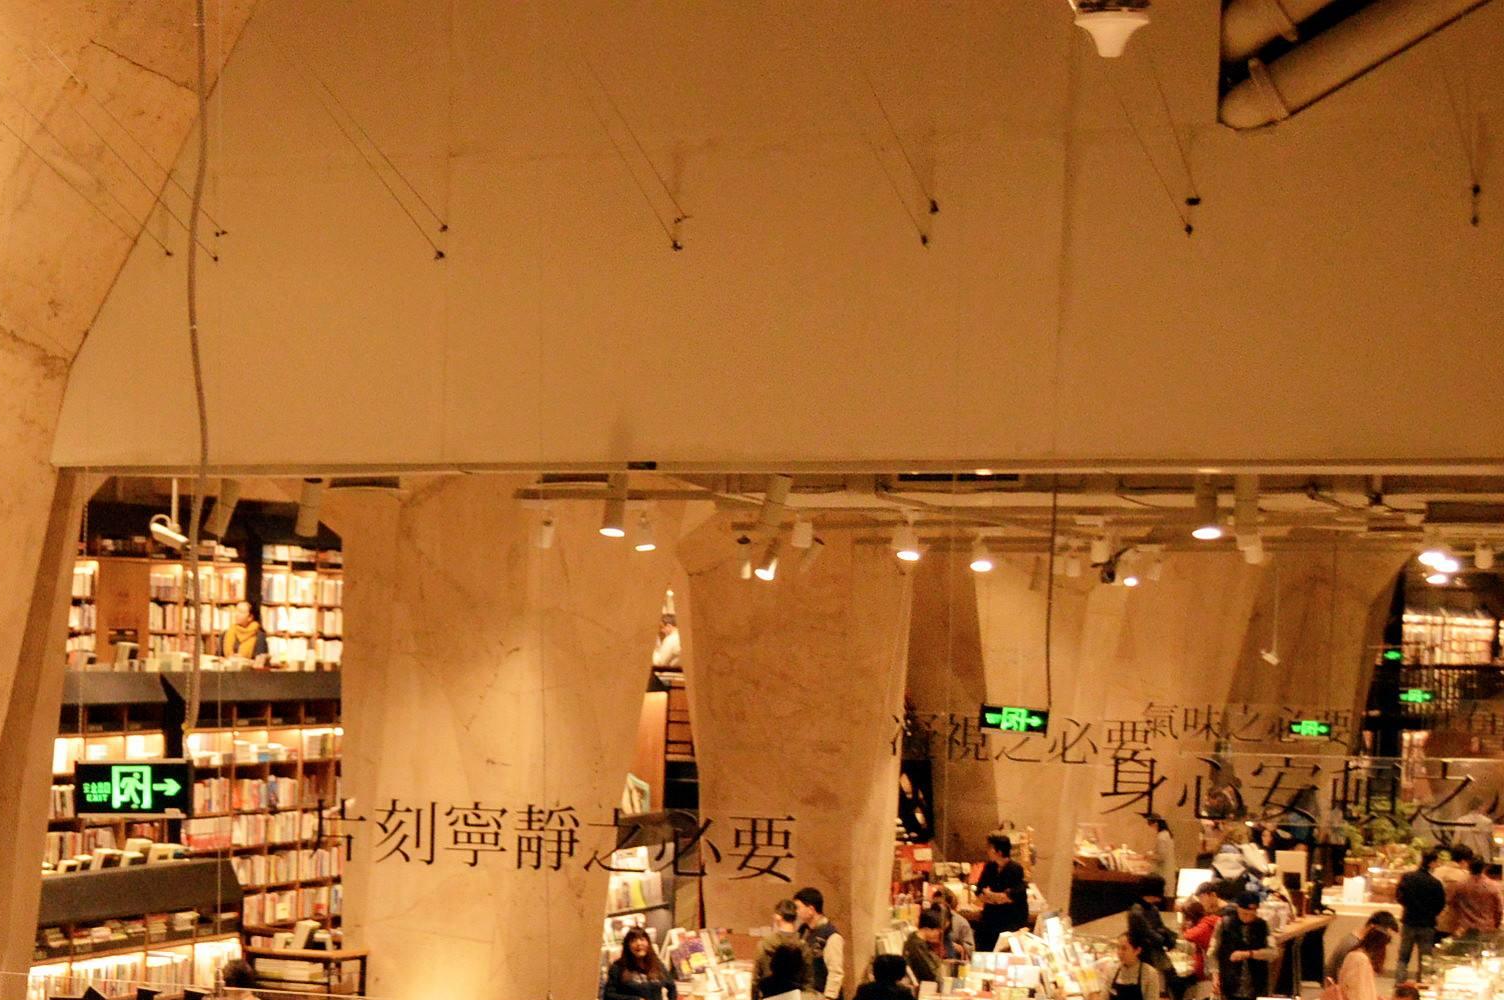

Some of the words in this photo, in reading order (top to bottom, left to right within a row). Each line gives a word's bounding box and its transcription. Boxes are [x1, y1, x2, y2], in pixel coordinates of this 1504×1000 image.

[85, 793, 109, 802] EXIT
[1100, 750, 1504, 828] 身心安頓之
[308, 797, 797, 883] 片刻寧靜之必要
